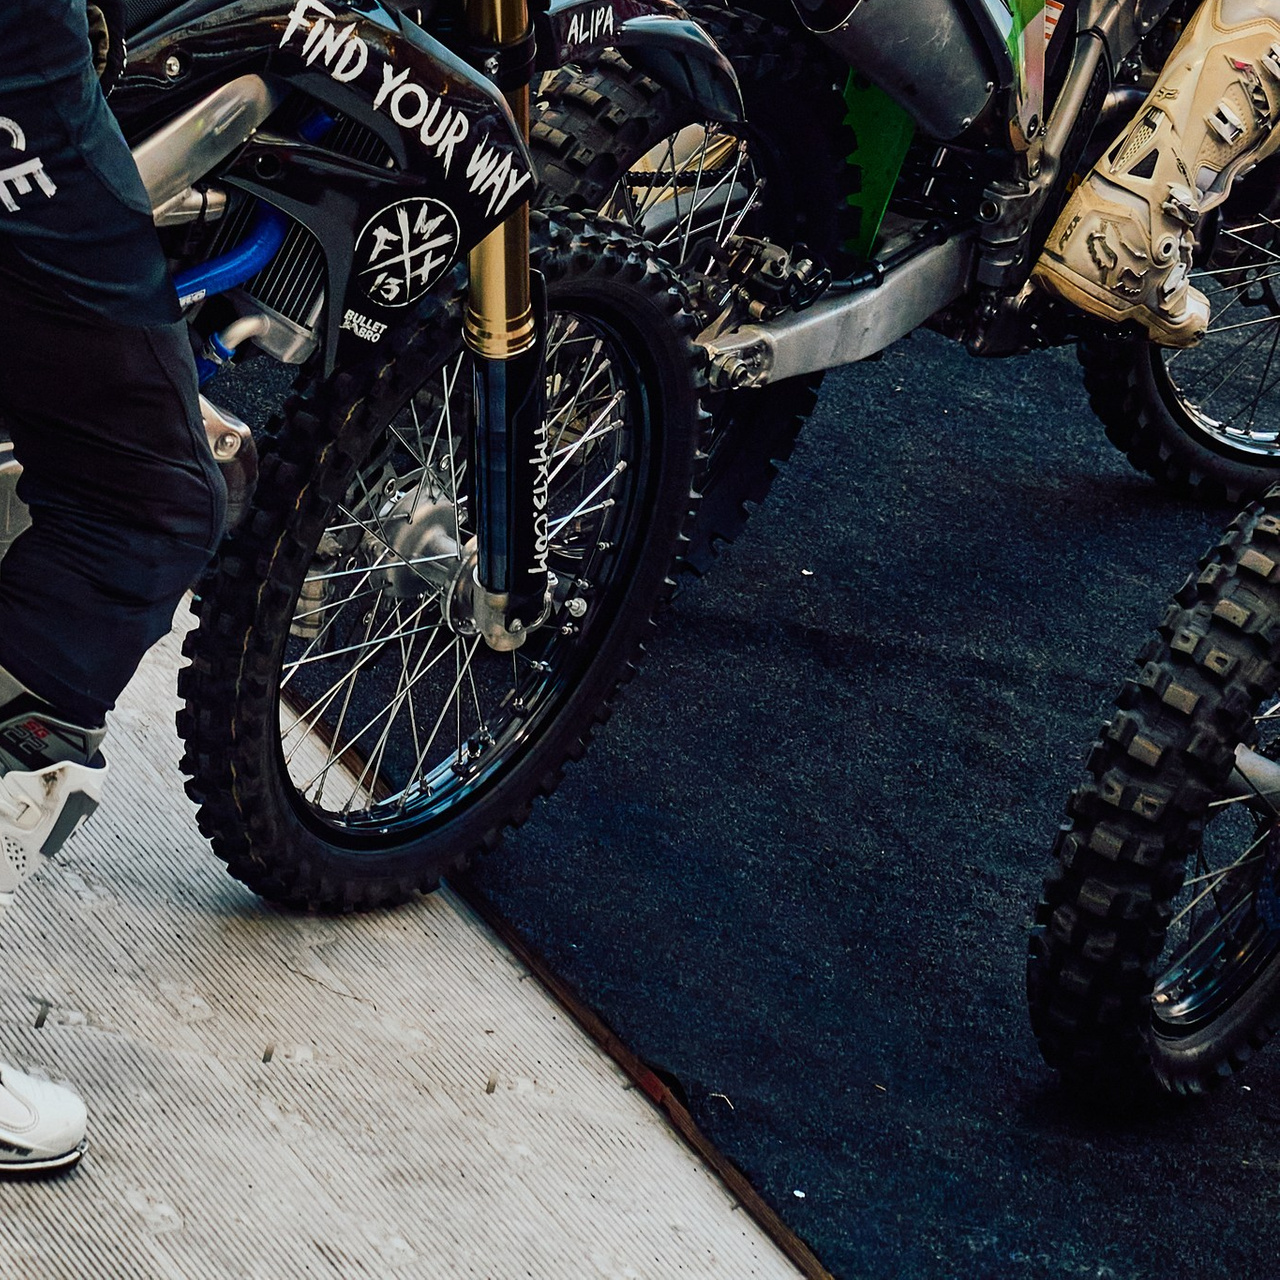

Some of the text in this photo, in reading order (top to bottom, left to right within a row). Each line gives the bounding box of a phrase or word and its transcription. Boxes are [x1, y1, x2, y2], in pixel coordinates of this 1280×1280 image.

[566, 4, 615, 46] ALIPA
[372, 61, 471, 181] YOUR
[465, 131, 533, 219] WAY
[343, 308, 389, 335] BULLET
[357, 326, 382, 344] BRO
